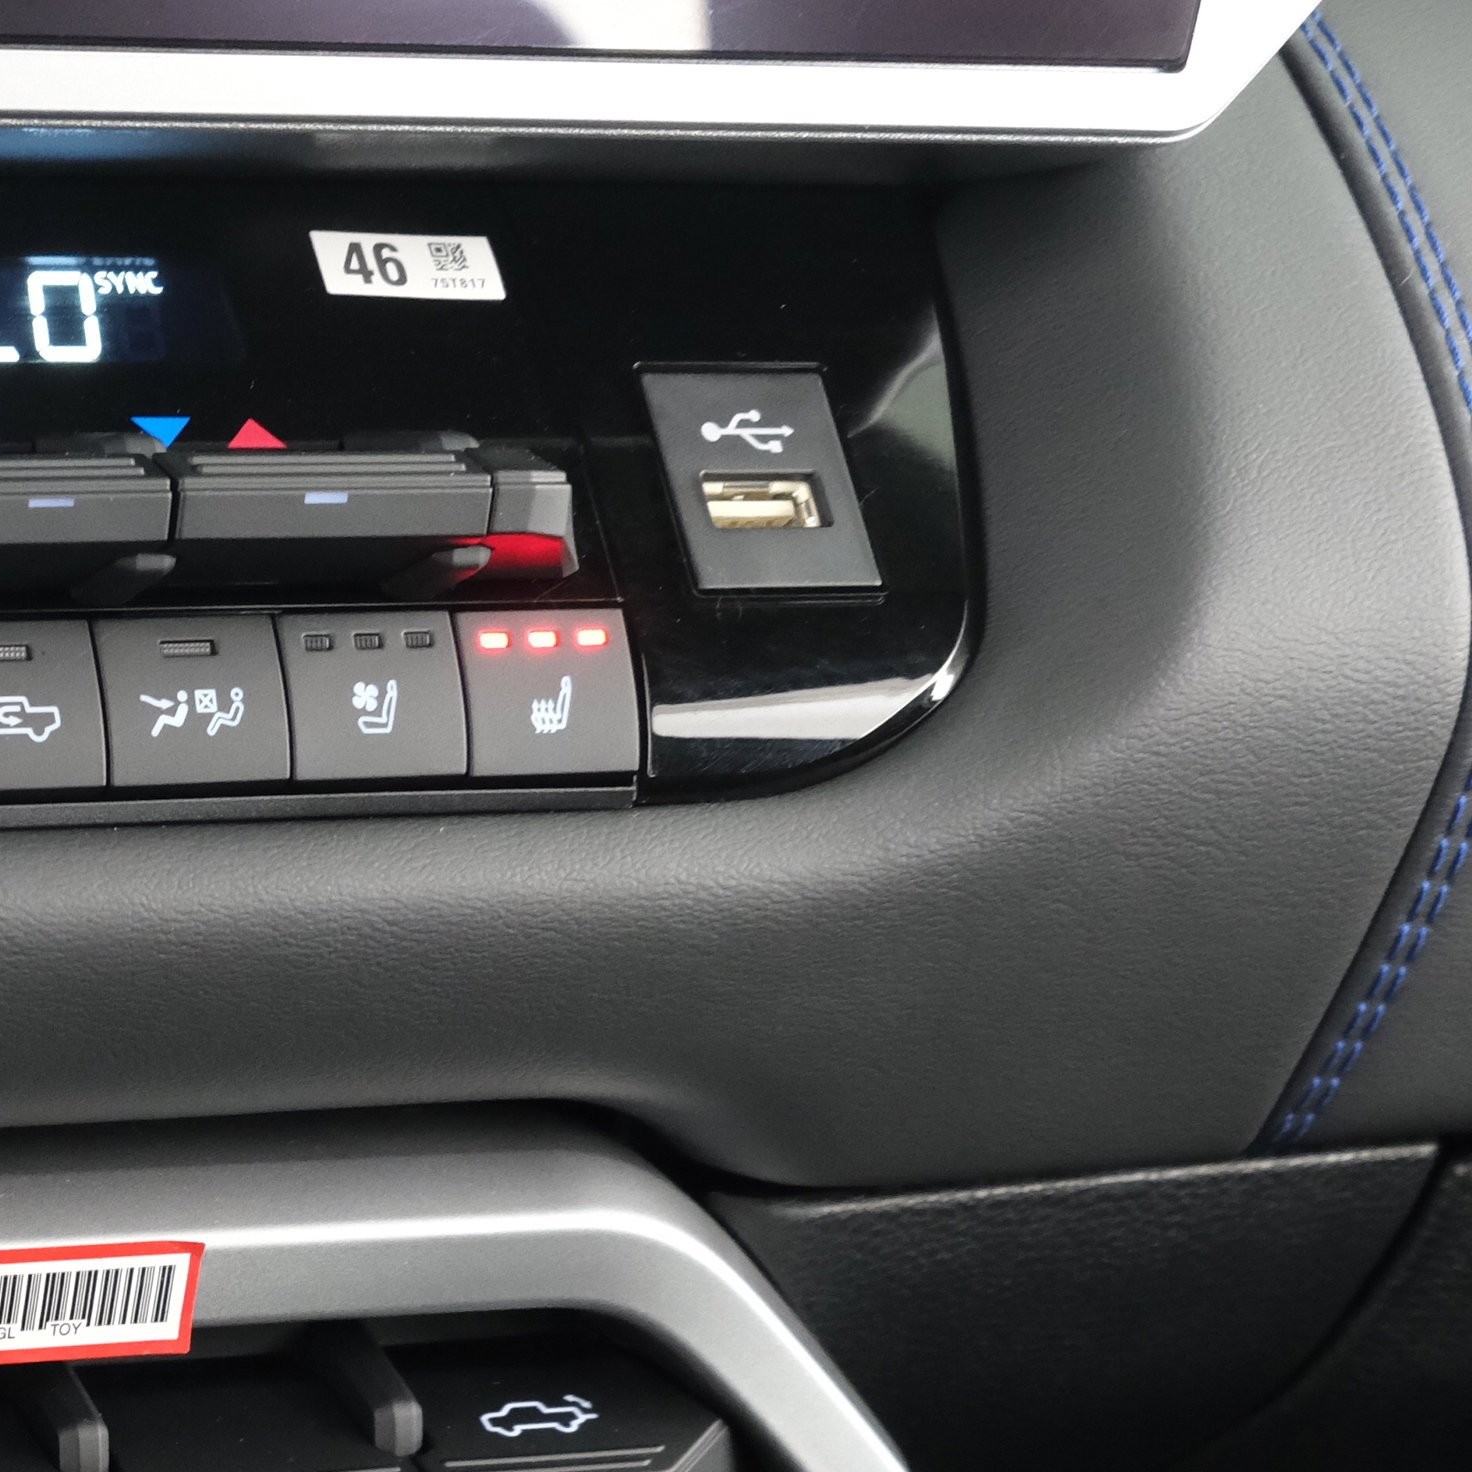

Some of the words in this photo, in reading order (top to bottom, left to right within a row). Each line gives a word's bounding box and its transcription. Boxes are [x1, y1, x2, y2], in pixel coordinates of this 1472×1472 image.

[343, 241, 408, 287] 46
[93, 270, 164, 295] SYNC
[51, 1322, 82, 1338] TOY
